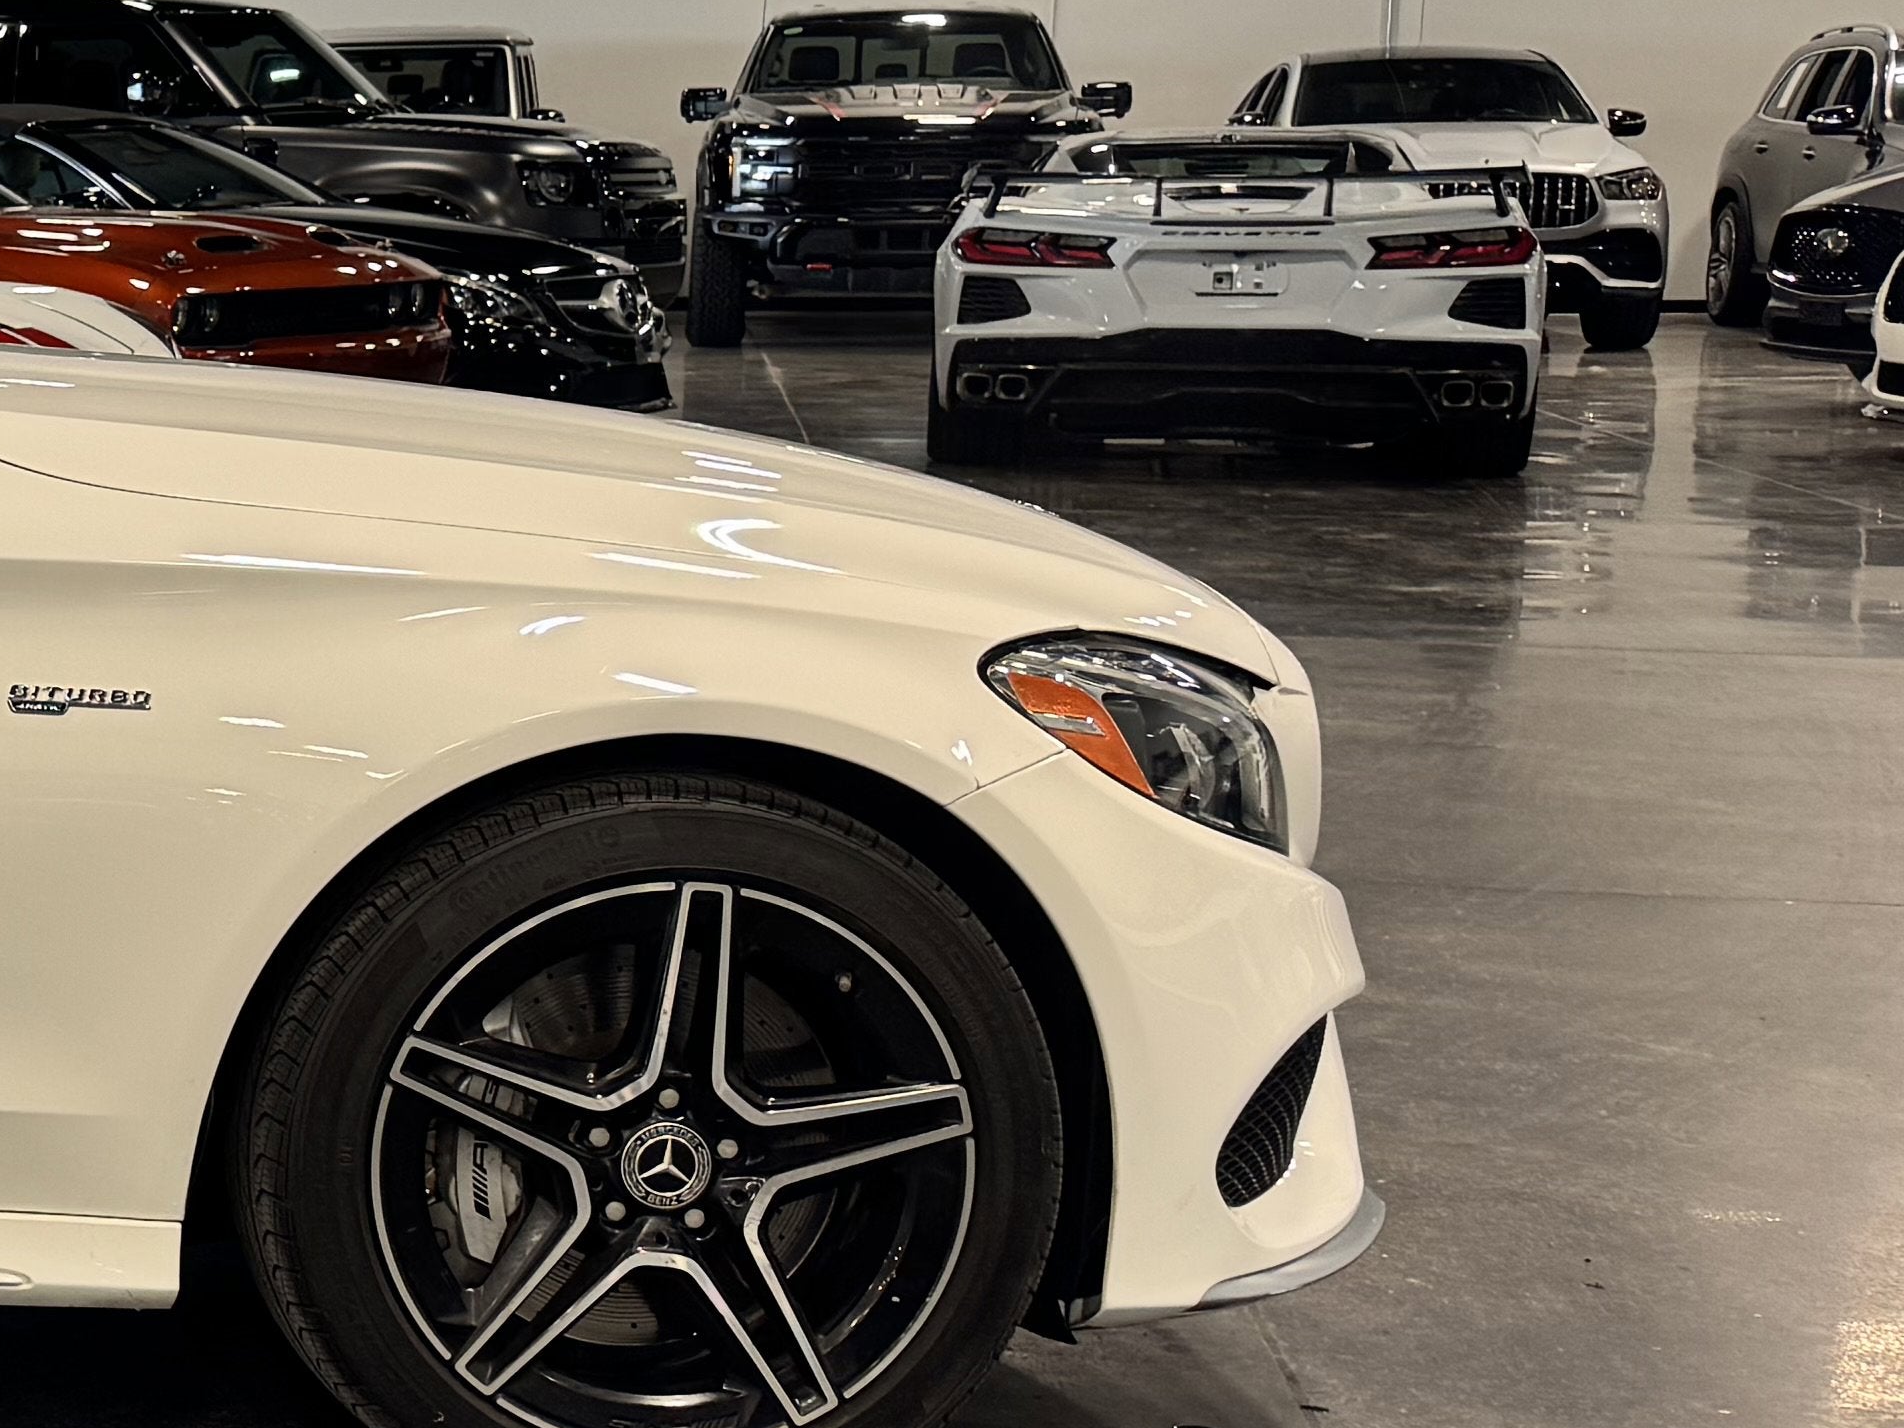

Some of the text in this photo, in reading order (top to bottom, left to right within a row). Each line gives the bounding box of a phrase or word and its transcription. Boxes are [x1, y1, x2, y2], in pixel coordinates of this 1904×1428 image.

[1160, 229, 1322, 237] CORVETTE
[8, 684, 152, 707] BITURBO
[640, 1125, 700, 1147] MERCEDES
[646, 1193, 679, 1206] BENZ
